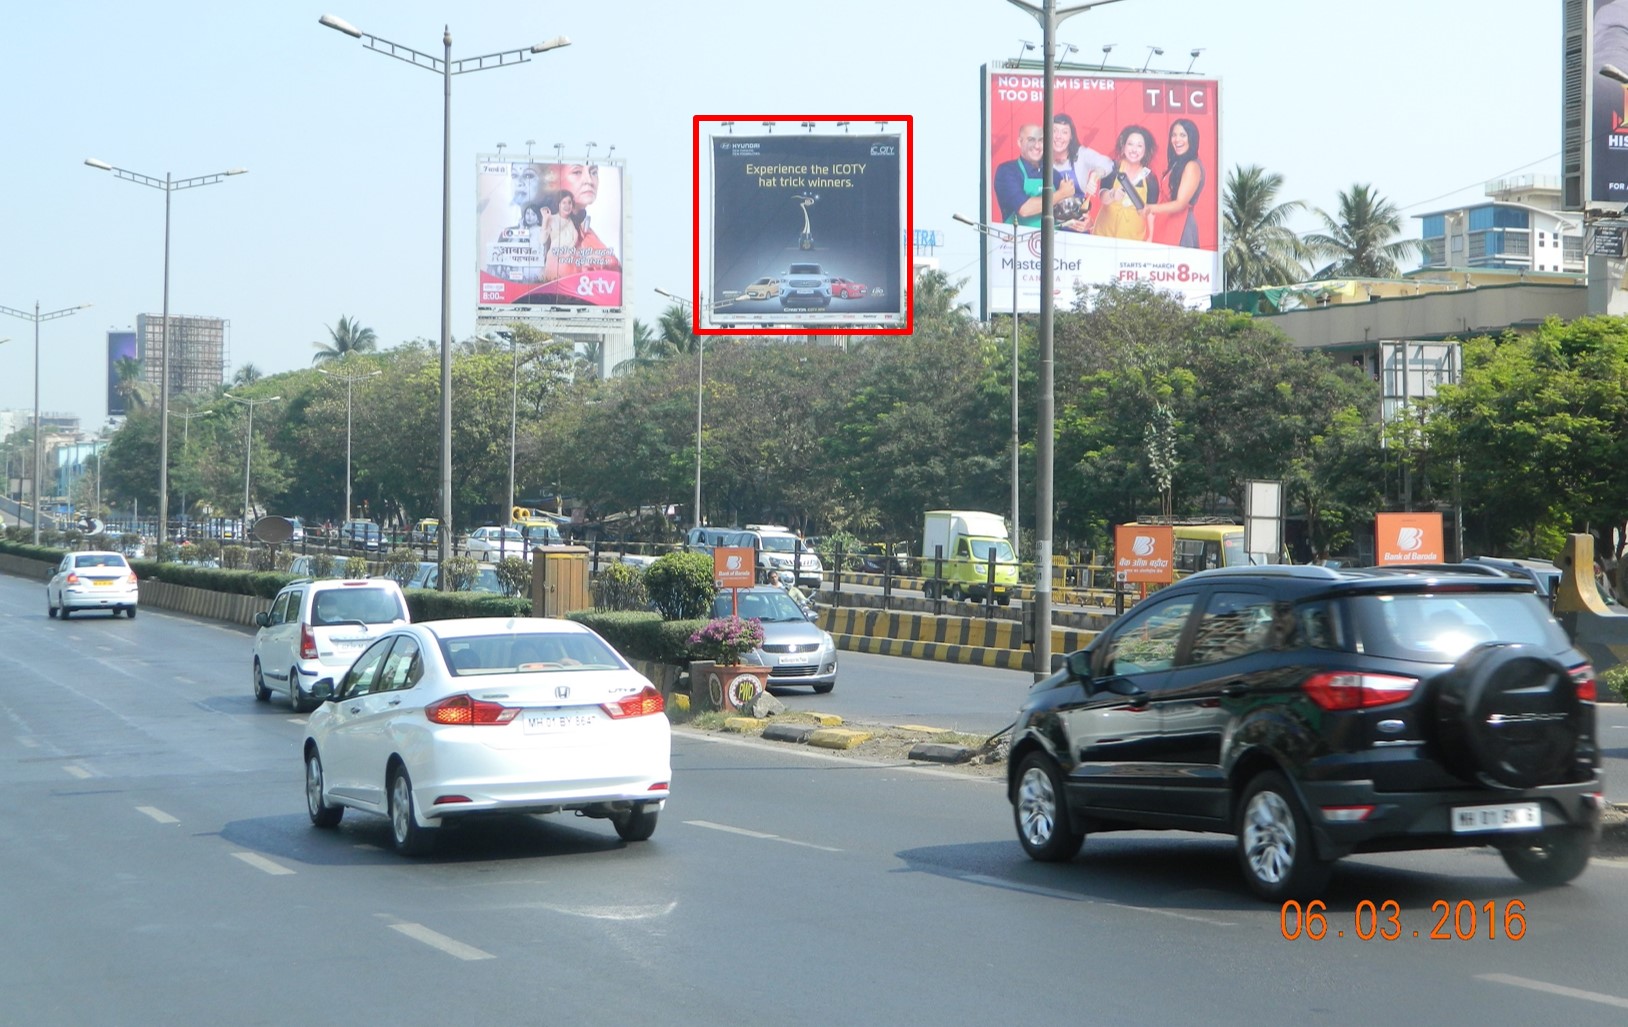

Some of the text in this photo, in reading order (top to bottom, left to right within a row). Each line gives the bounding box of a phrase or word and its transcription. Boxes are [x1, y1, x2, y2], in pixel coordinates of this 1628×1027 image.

[998, 76, 1018, 88] NO
[1070, 78, 1081, 90] IS
[1083, 79, 1115, 91] EVER
[998, 89, 1028, 102] TOO
[746, 163, 867, 177] Experience the ICOTY
[758, 176, 854, 188] hat trick winners.
[1609, 182, 1625, 190] FOR
[1002, 257, 1082, 271] MasteChef
[1150, 271, 1175, 282] SUN
[577, 275, 616, 296] &tv
[1384, 551, 1437, 561] Bank of Baroda
[738, 681, 754, 701] PWD
[528, 717, 543, 728] MH
[560, 715, 571, 727] BY
